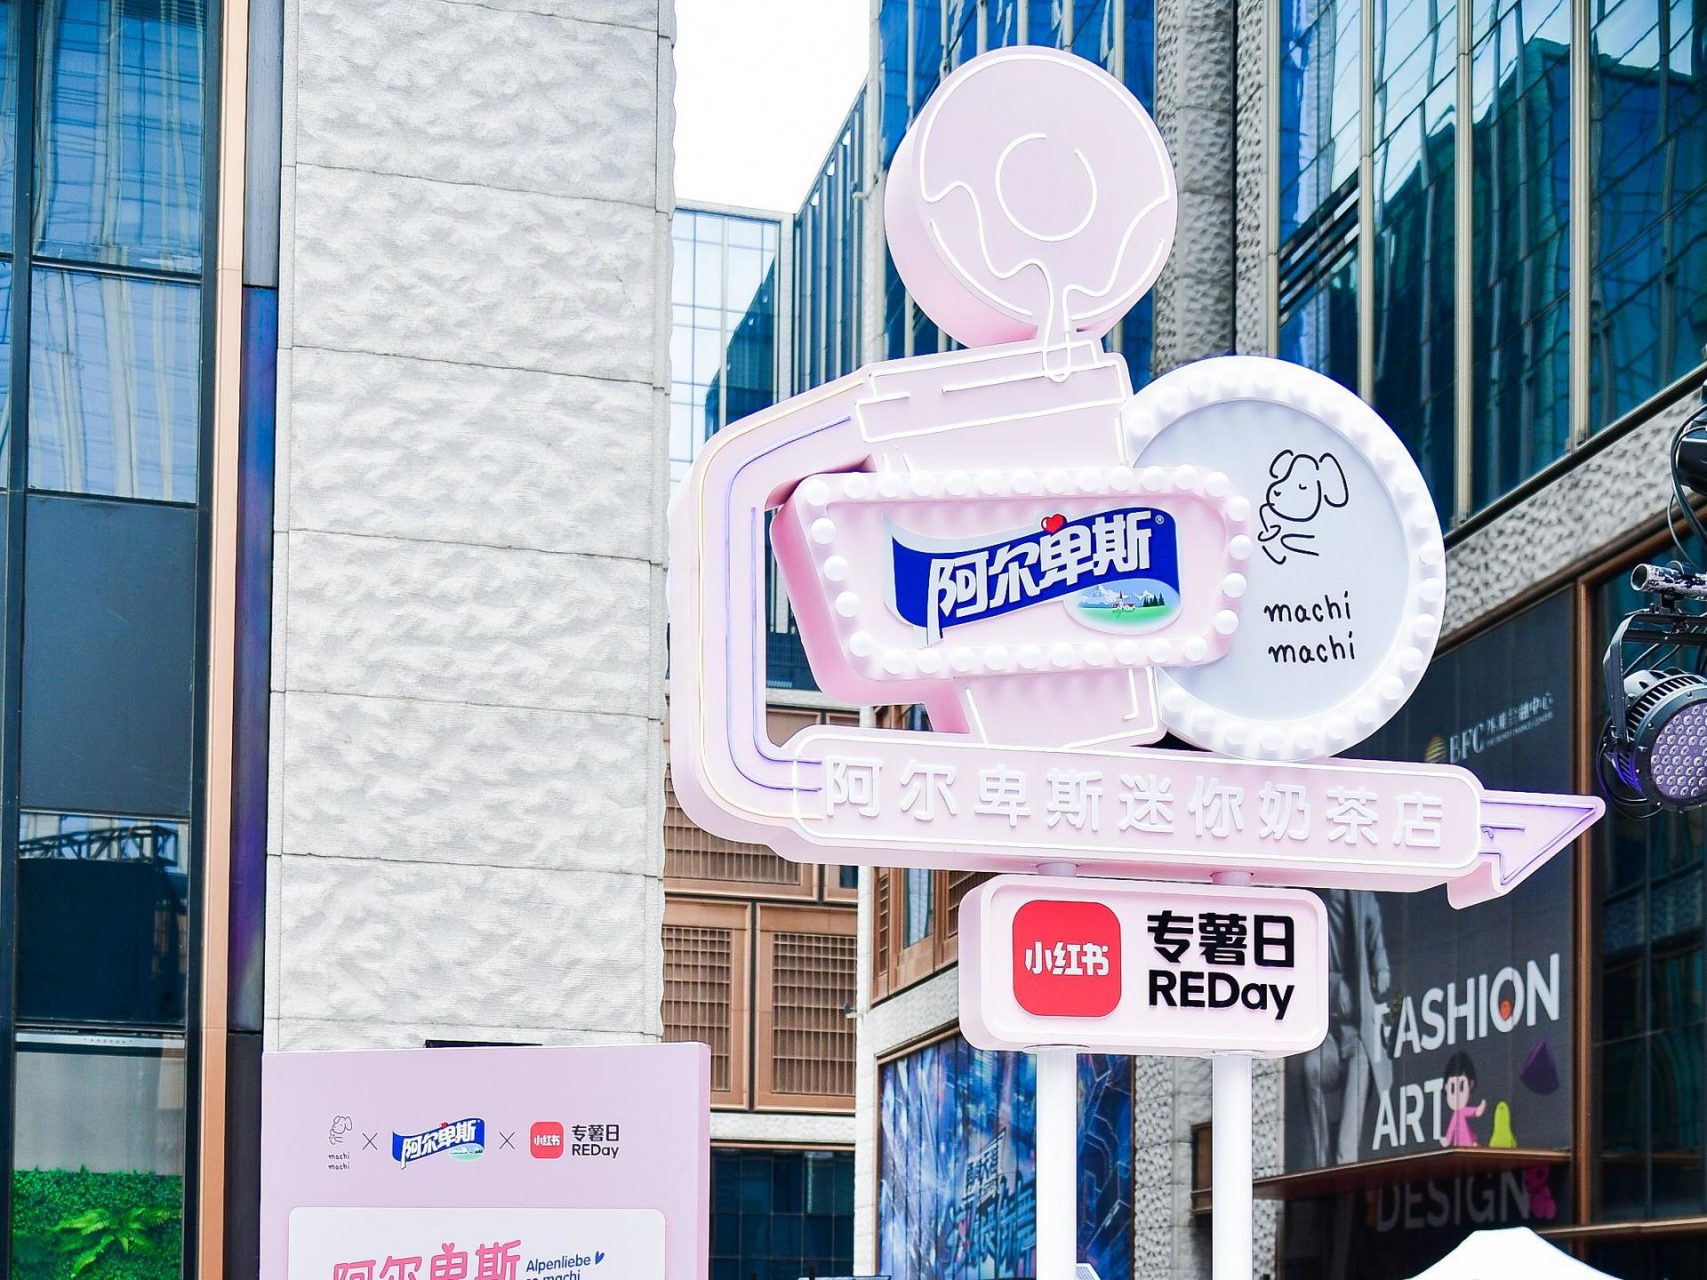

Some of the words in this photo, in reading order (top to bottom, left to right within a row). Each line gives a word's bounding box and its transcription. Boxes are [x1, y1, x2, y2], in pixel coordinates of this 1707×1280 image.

[927, 509, 1153, 646] 阿尔卑斯
[1264, 591, 1352, 623] machi
[1268, 632, 1356, 663] machi
[822, 755, 1444, 848] 阿尔卑斯迷你奶茶店
[1146, 910, 1297, 967] 专薯日
[1024, 940, 1110, 977] 小红书
[1147, 969, 1296, 1021] REDay
[1373, 952, 1560, 1063] FASHION
[1371, 1077, 1444, 1150] ART
[401, 1119, 477, 1170] 阿尔卑斯
[533, 1135, 561, 1147] 小红书
[571, 1124, 620, 1142] 专薯日
[571, 1144, 620, 1159] REDay
[328, 1152, 351, 1160] machi
[328, 1163, 351, 1171] machi
[1375, 1170, 1532, 1233] DESIGN
[525, 1253, 592, 1274] Alpenliebe
